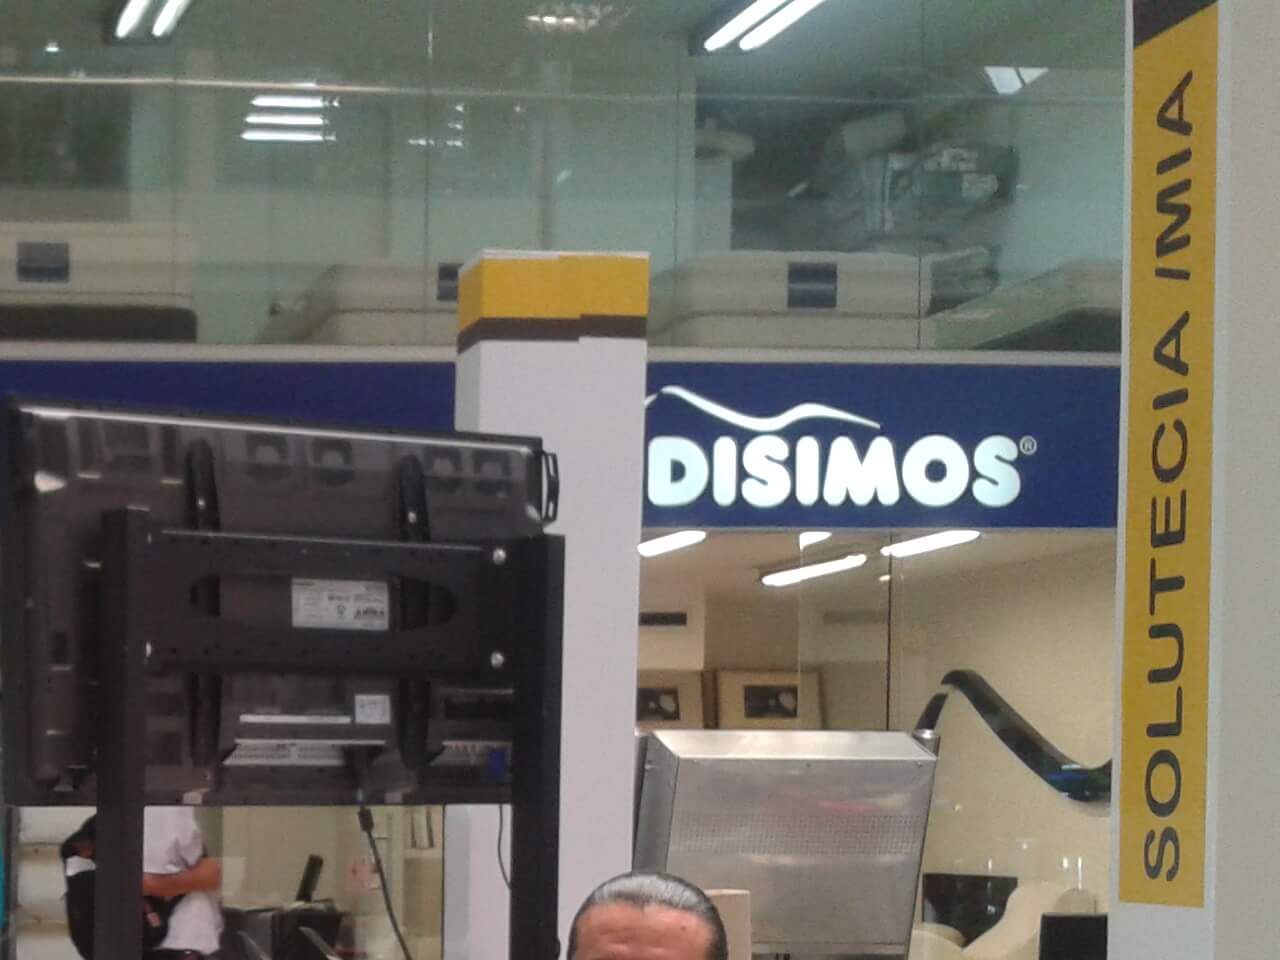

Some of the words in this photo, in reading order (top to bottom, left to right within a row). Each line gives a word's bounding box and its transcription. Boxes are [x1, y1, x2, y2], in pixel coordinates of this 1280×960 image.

[1154, 70, 1193, 280] IMIA
[648, 435, 1021, 507] DISIMOS
[1144, 310, 1190, 882] SOLUTECIA
